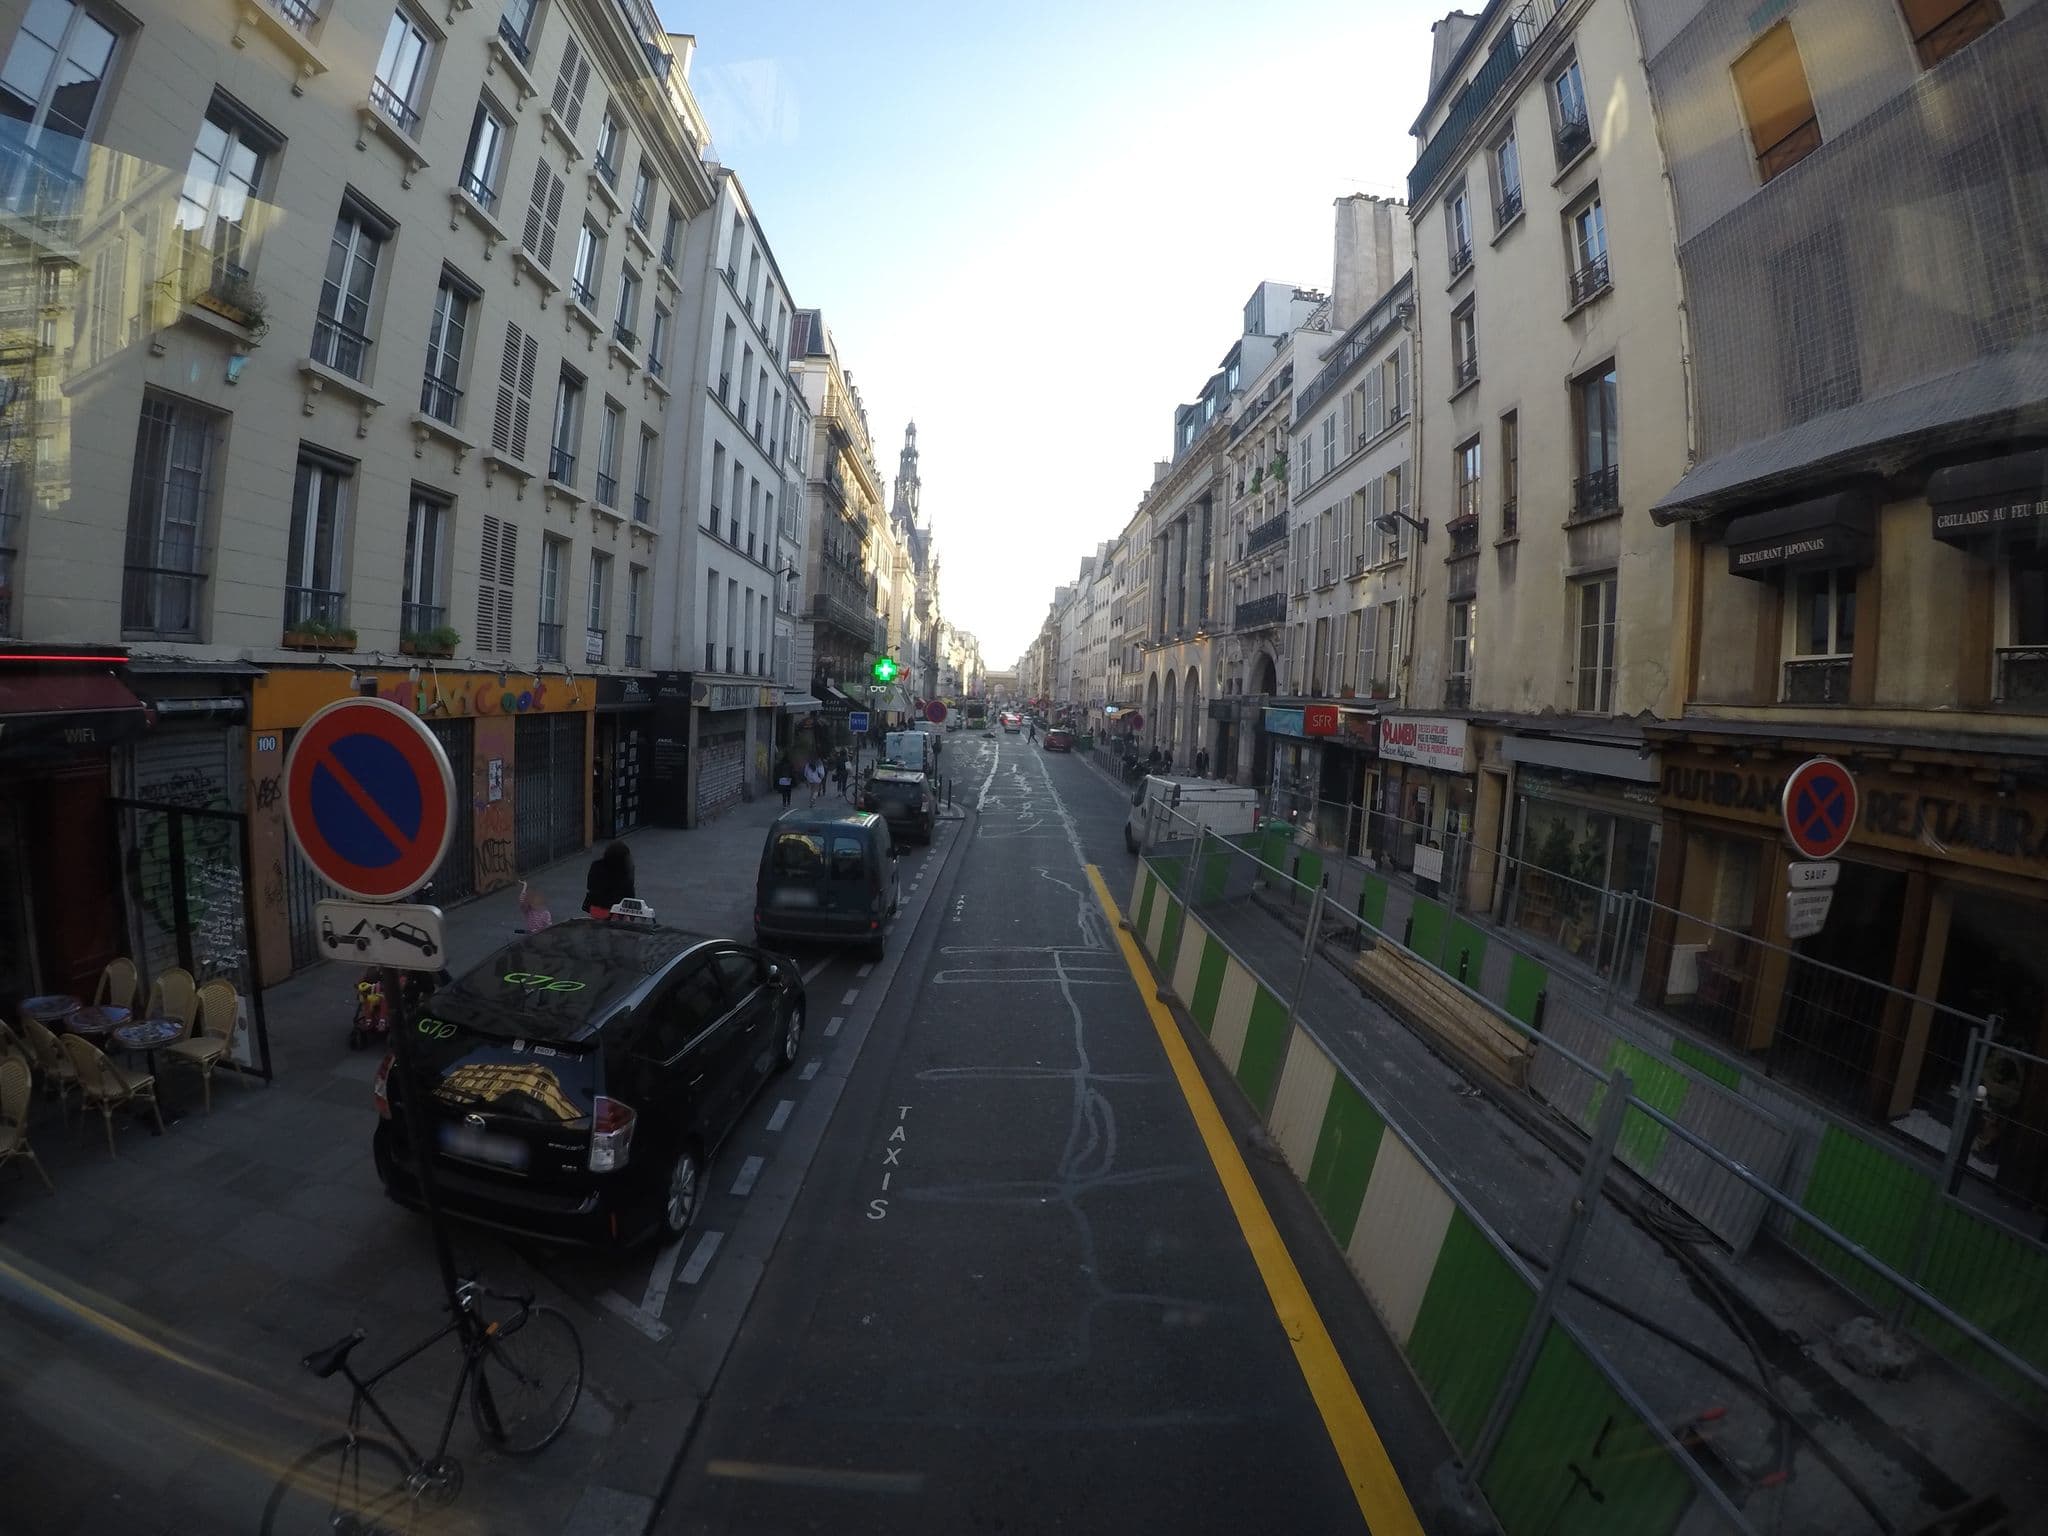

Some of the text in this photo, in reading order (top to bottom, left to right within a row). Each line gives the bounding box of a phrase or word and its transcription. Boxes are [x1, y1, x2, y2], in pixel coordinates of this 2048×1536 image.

[1937, 510, 1989, 528] GRILLADES
[1993, 507, 2007, 521] AU
[2011, 504, 2032, 519] FEU
[1738, 538, 1825, 564] RESTAURANT JAPONNAIS
[1312, 714, 1332, 729] SFR
[257, 736, 277, 752] 100
[1804, 869, 1827, 881] SAUF
[866, 1105, 913, 1222] TAXIS
